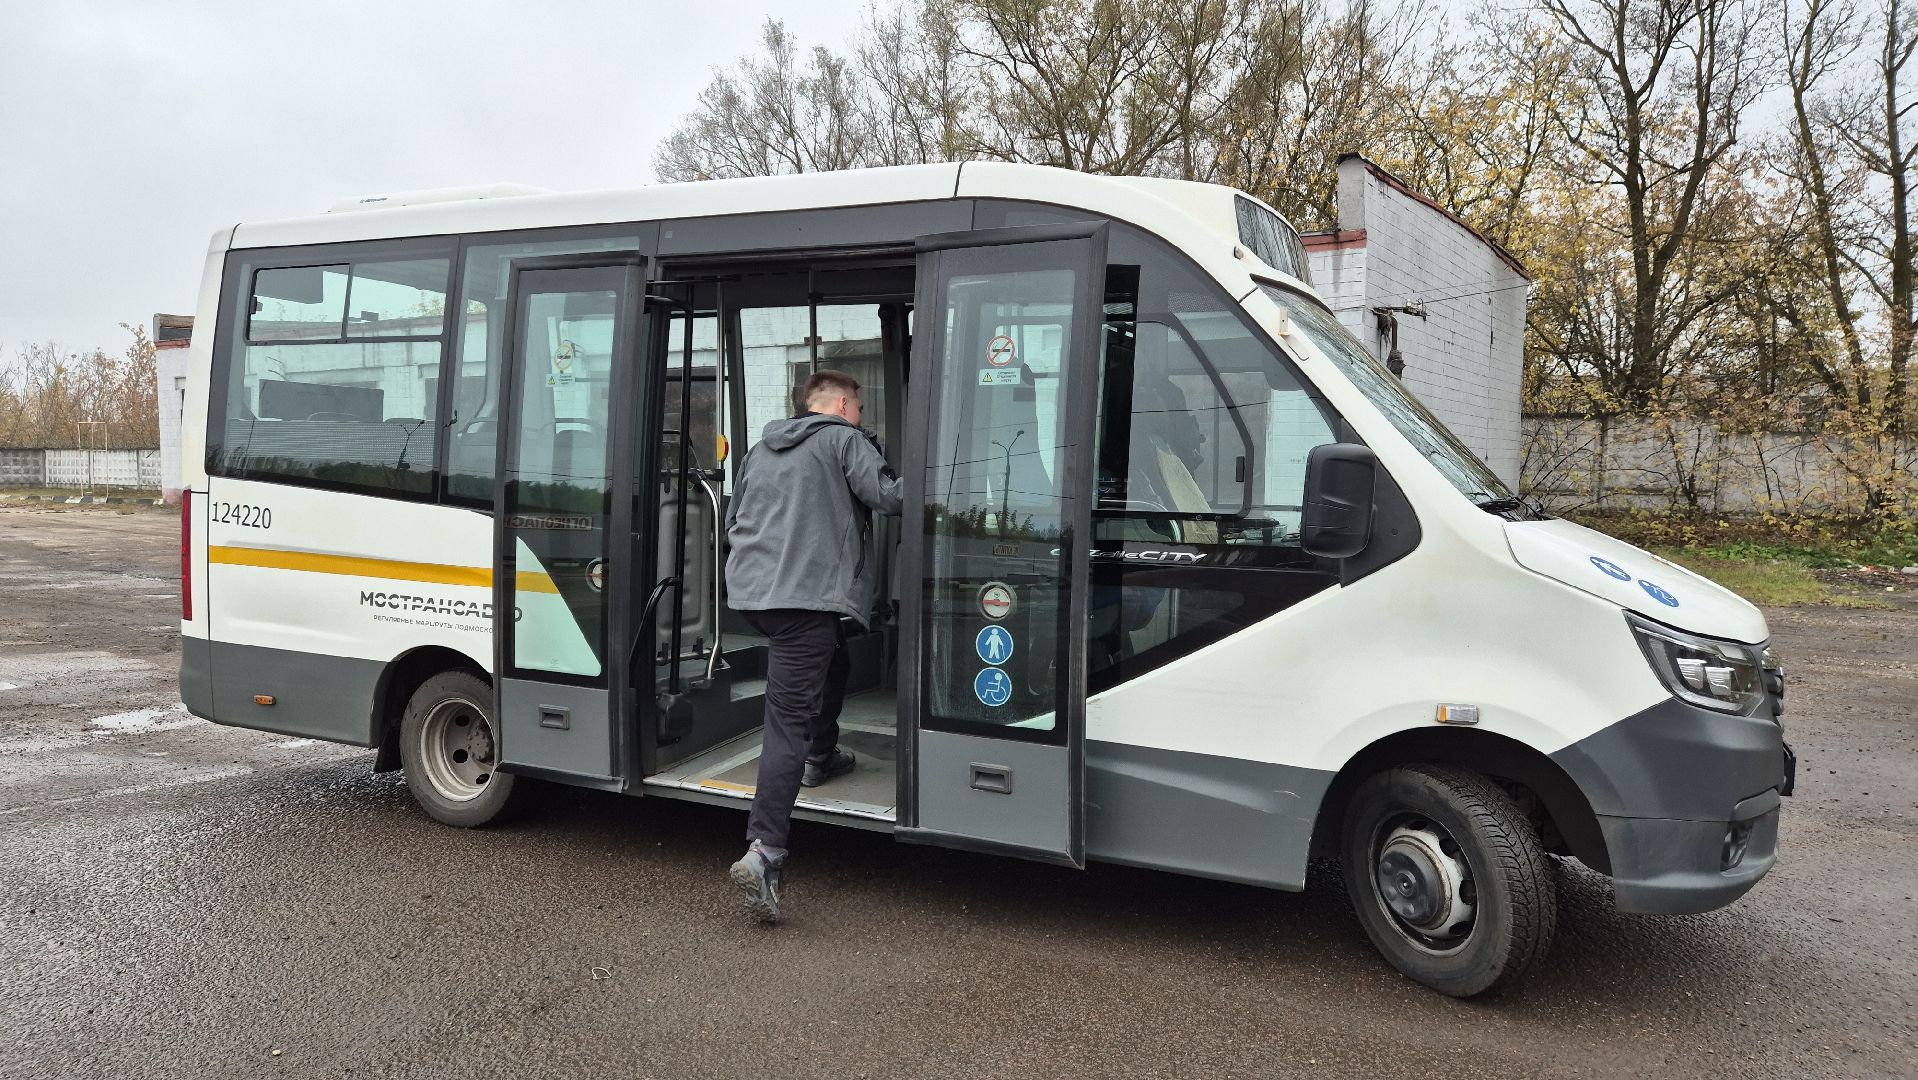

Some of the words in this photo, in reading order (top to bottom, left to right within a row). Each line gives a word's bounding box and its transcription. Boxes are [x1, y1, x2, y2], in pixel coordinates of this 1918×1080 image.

[212, 501, 272, 529] 124220
[360, 590, 523, 622] МОСТРАНСАВО
[454, 623, 493, 634] ПОДМОСКО
